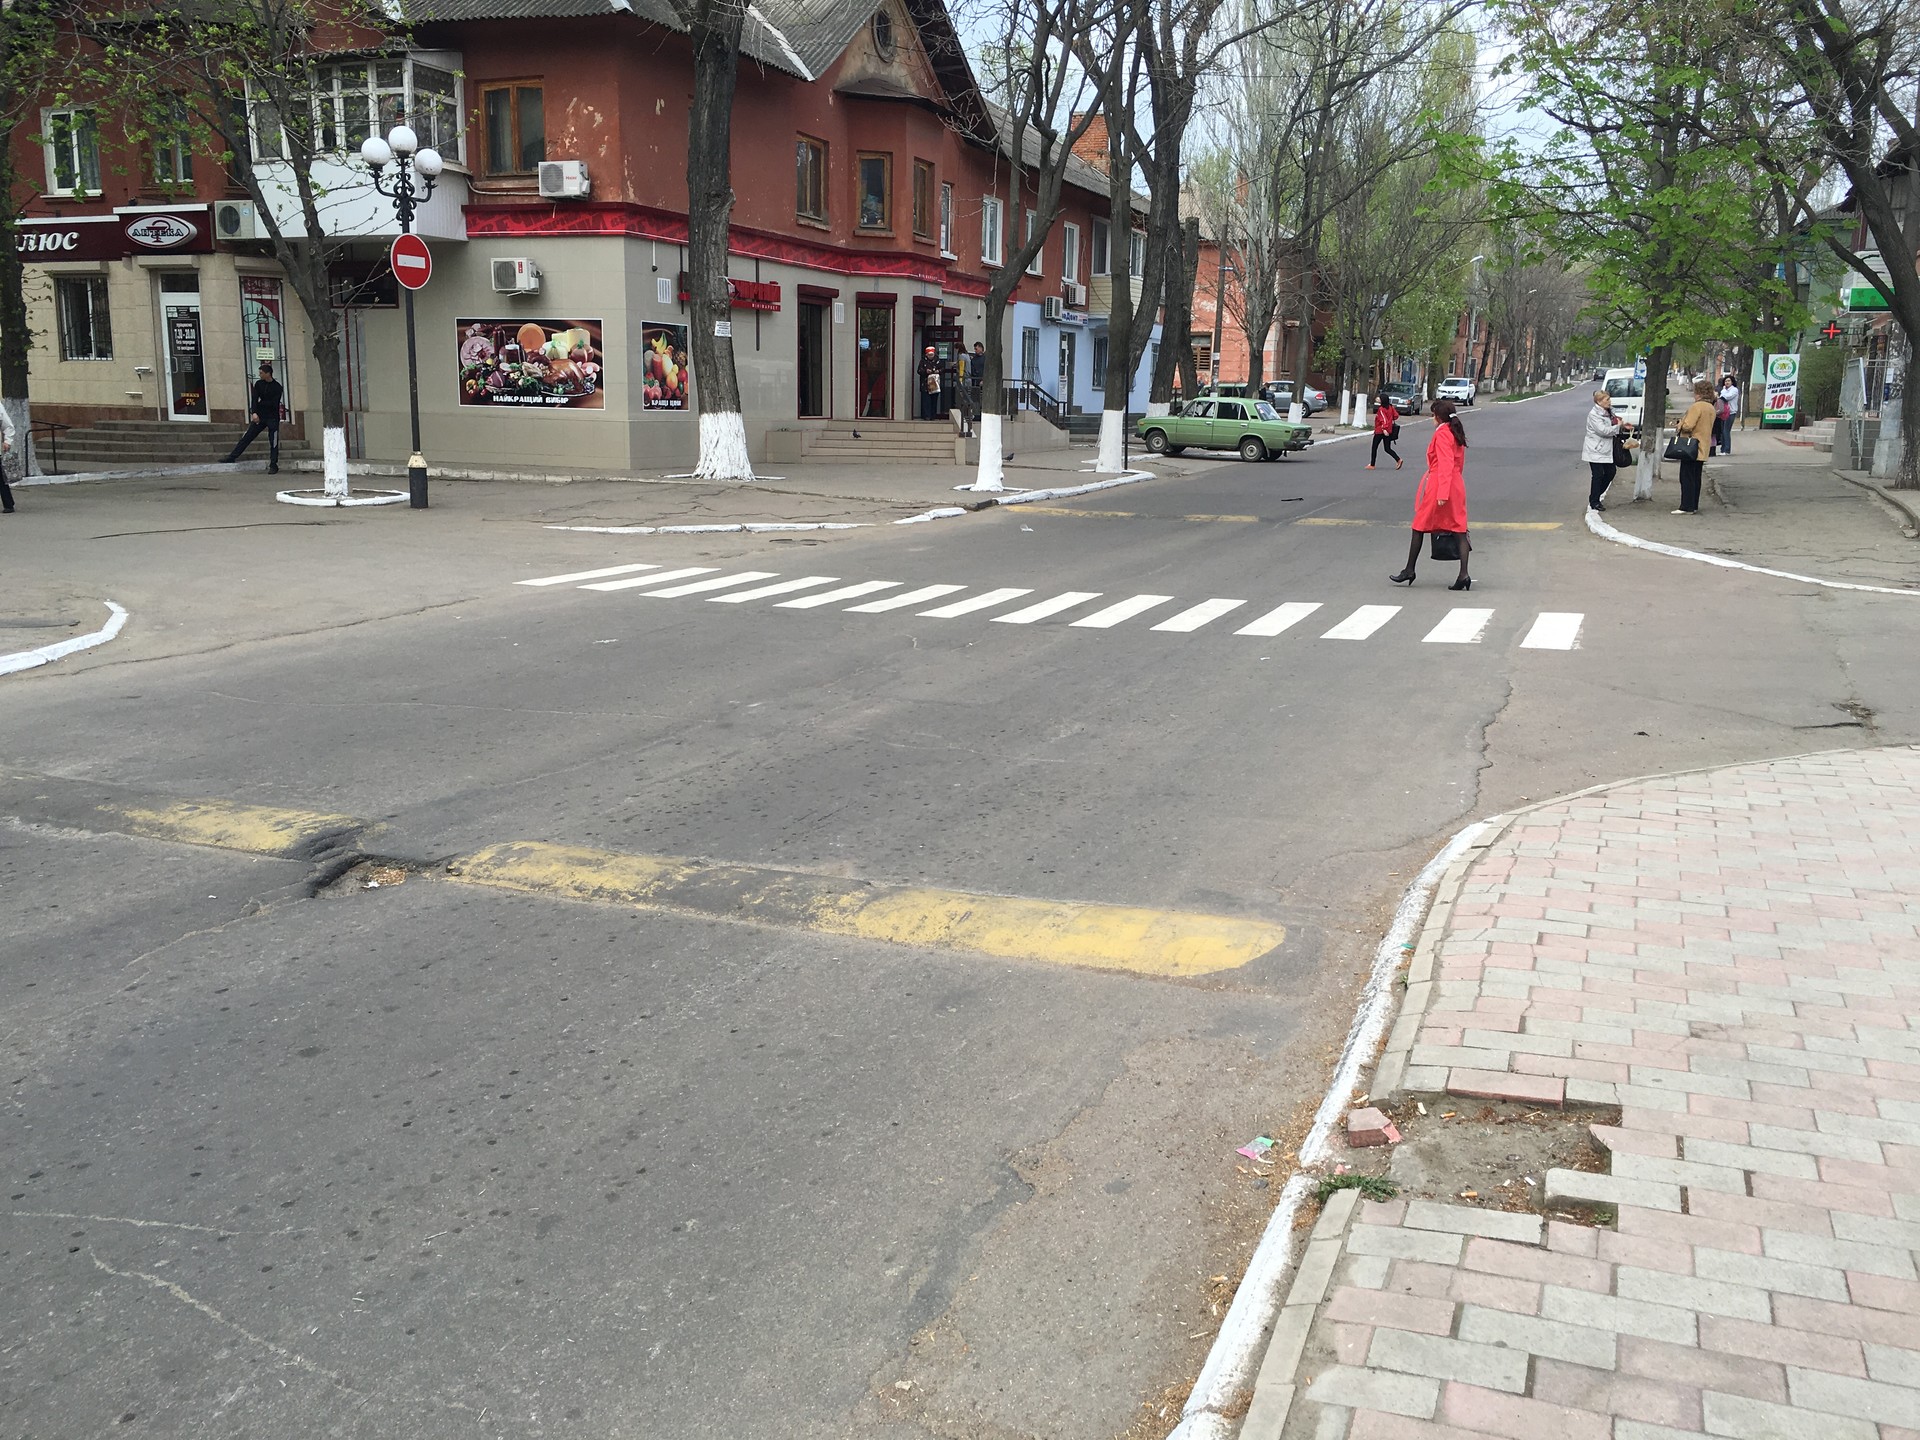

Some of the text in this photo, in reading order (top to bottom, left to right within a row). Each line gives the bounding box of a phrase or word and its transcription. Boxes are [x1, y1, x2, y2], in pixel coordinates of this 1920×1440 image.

[131, 228, 184, 237] АПТЕКА
[14, 231, 80, 252] ЛЮС
[492, 394, 569, 404] НАЙКРАЩИЙ ВИБІР
[1771, 394, 1794, 410] 10%
